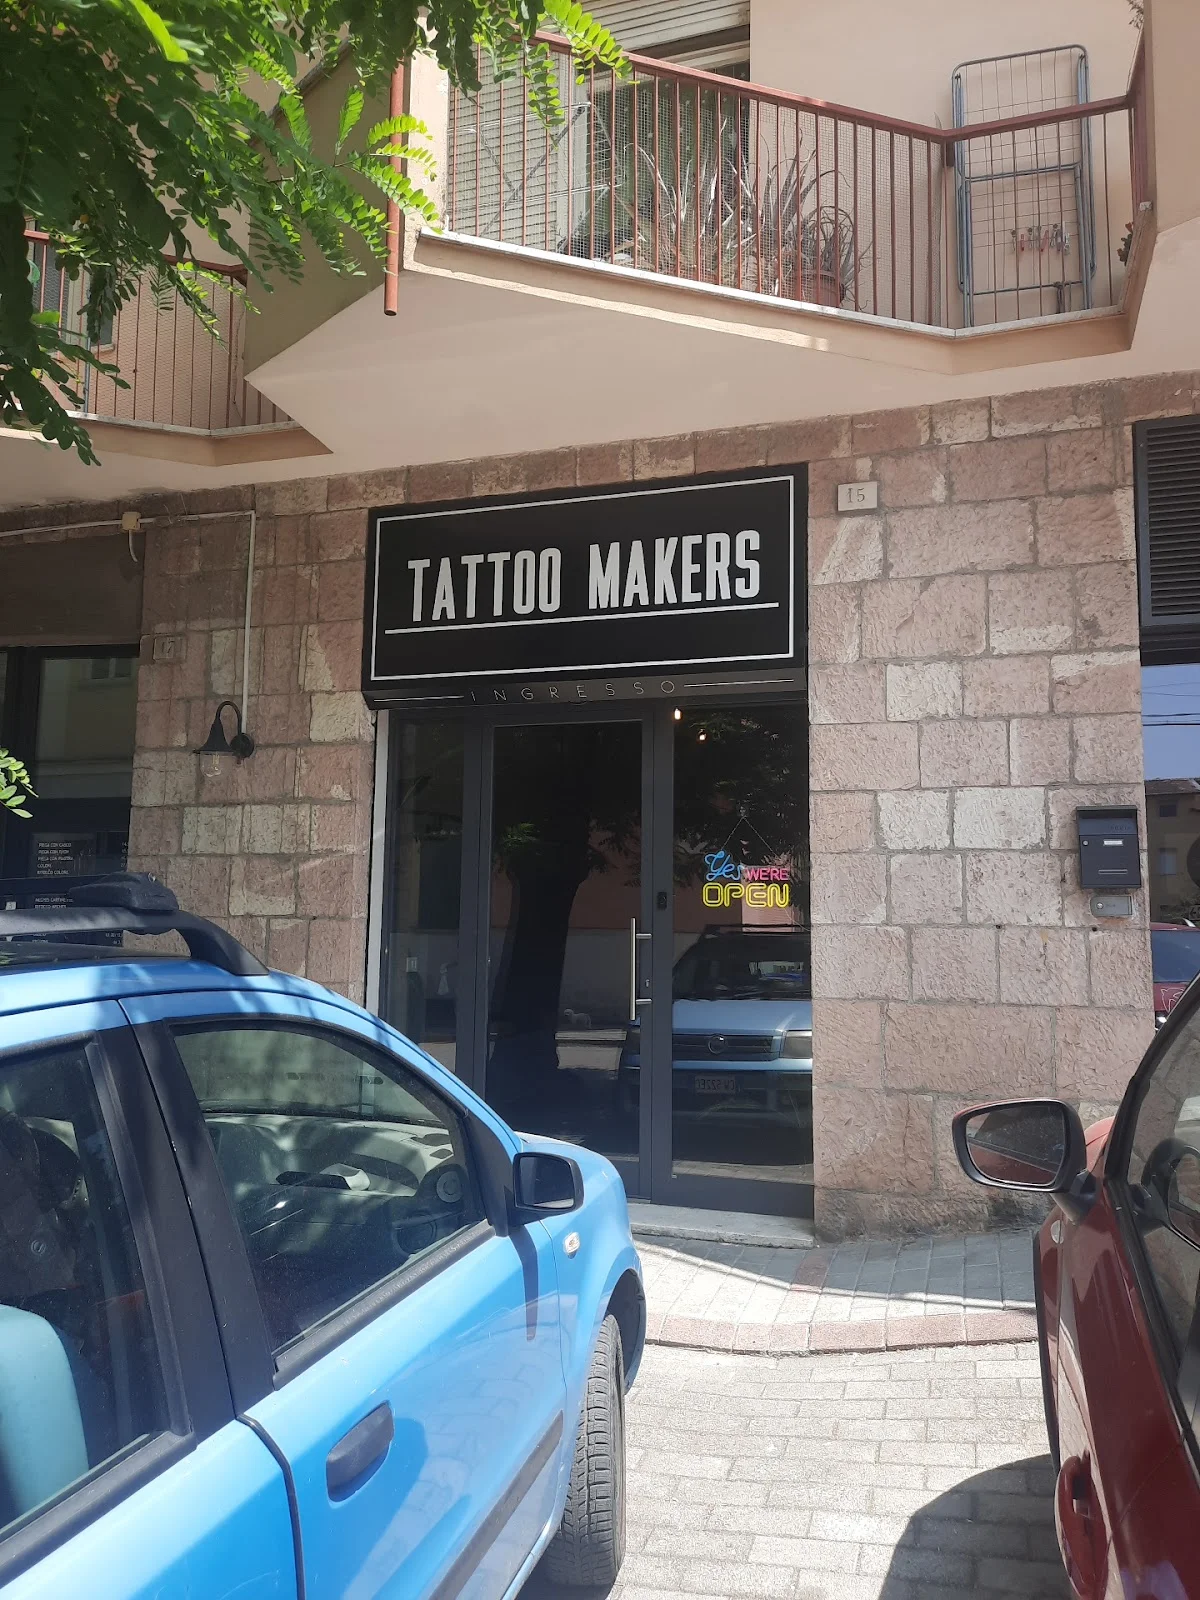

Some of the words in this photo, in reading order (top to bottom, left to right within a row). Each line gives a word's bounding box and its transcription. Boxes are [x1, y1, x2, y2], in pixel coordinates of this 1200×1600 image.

[846, 487, 866, 504] 15
[407, 547, 562, 622] TATTOO
[588, 529, 760, 610] MAKERS
[470, 680, 676, 702] INGRESSO
[704, 850, 746, 881] Yes
[702, 882, 790, 908] OPEN
